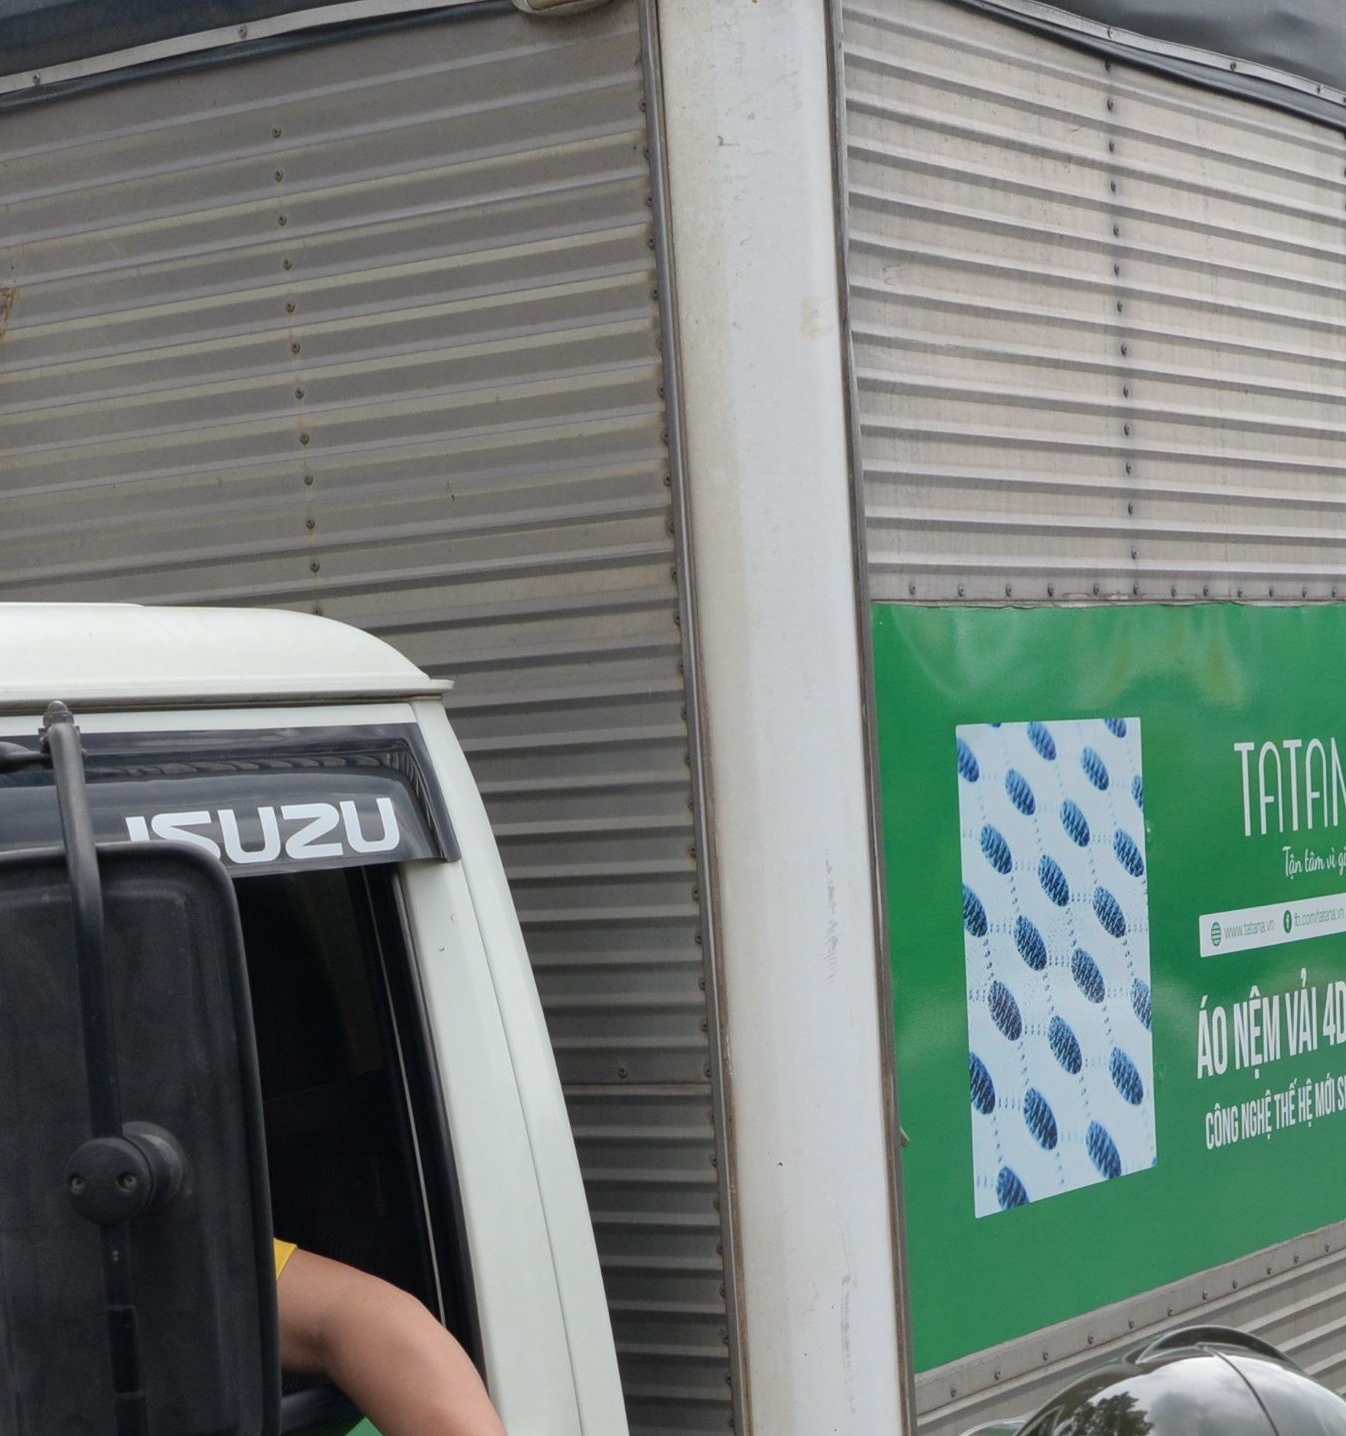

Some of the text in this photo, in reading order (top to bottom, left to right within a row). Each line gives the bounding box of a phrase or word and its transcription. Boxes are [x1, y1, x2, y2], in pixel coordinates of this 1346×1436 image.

[1282, 846, 1302, 880] Tận
[1304, 848, 1325, 873] tâm
[1224, 918, 1275, 940] www.tatana.vn
[1197, 994, 1228, 1079] ÁO
[1233, 985, 1281, 1080] NỆM
[1285, 967, 1318, 1056] VẢI
[1205, 1102, 1239, 1150] CÔNG
[1241, 1089, 1272, 1140] NGHỆ
[1274, 1078, 1298, 1130] THẾ
[1298, 1078, 1313, 1128] HỆ
[1315, 1072, 1336, 1118] MỚI
